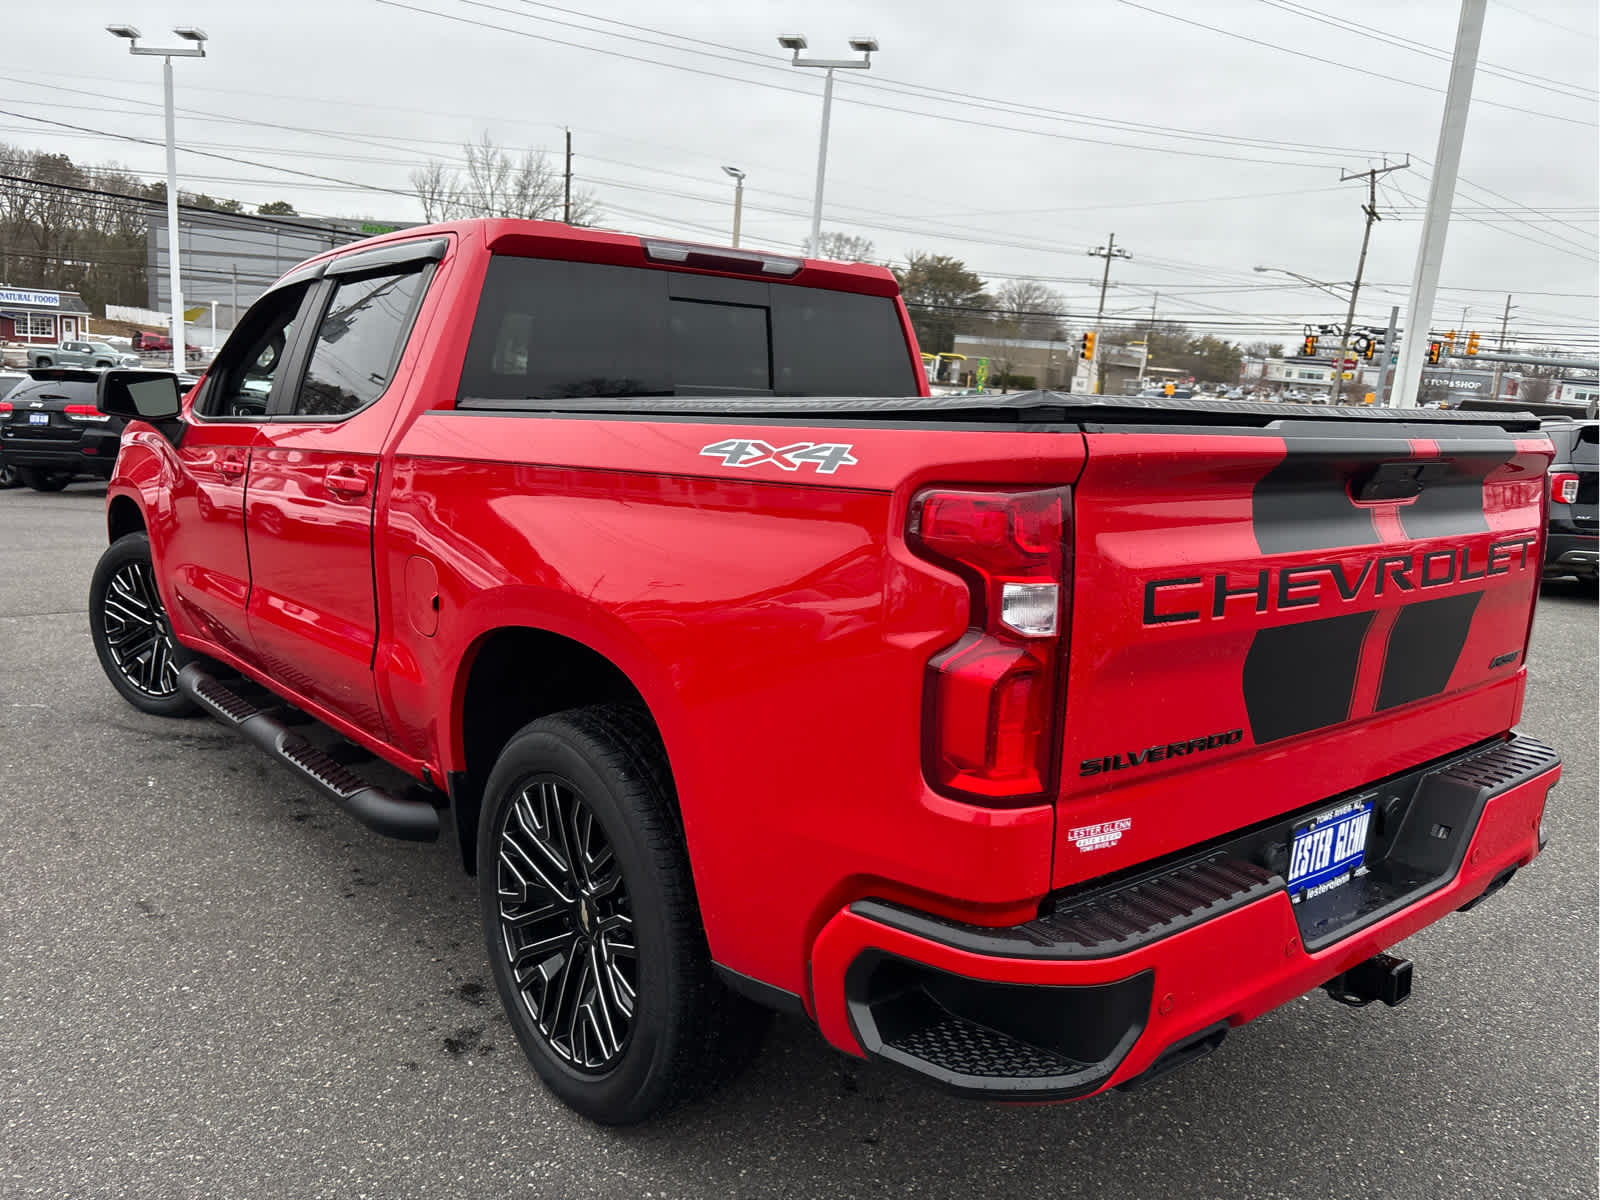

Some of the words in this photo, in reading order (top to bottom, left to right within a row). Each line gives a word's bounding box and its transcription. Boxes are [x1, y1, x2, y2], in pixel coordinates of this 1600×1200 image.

[0, 292, 32, 302] NATURAL
[34, 295, 58, 304] FOODS
[1142, 536, 1535, 628] CHEVROLET
[1080, 728, 1243, 777] SILVERADO
[1068, 826, 1102, 841] LESTER
[1103, 819, 1131, 833] GLENN
[1288, 828, 1334, 881] LESTER
[1334, 813, 1370, 863] GLENN
